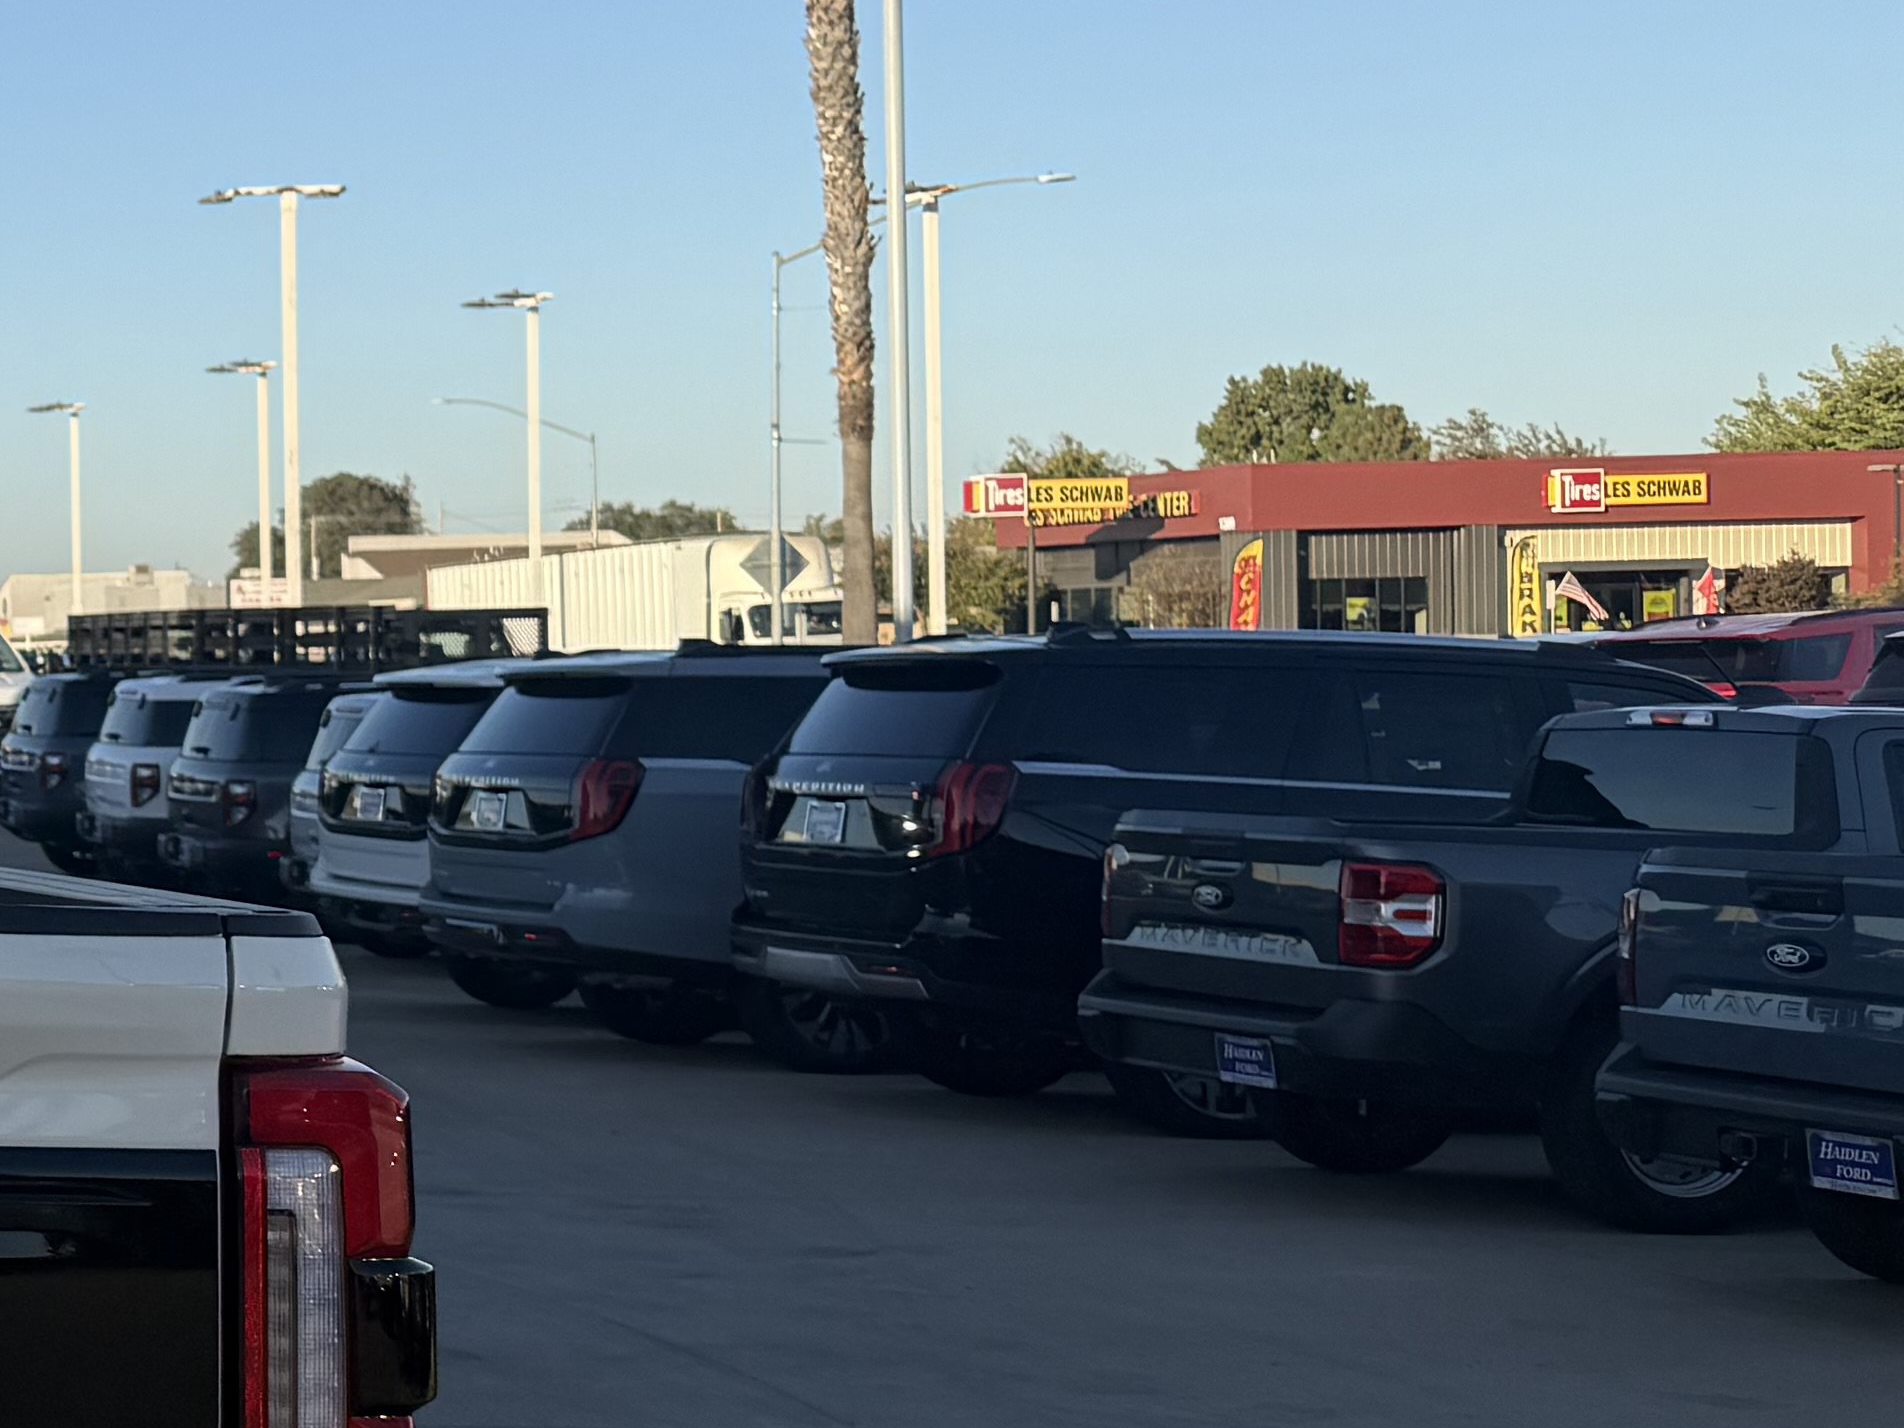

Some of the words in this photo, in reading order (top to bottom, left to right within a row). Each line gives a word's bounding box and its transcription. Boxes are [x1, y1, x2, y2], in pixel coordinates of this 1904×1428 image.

[986, 480, 1025, 510] Tires
[1027, 486, 1054, 504] LES
[1059, 485, 1124, 504] SCHWAB
[1561, 475, 1601, 507] Tires
[1604, 480, 1631, 498] LES
[1636, 479, 1703, 498] SCHWAB
[1818, 1140, 1880, 1165] HAIDLEN
[1835, 1164, 1872, 1182] FORD
